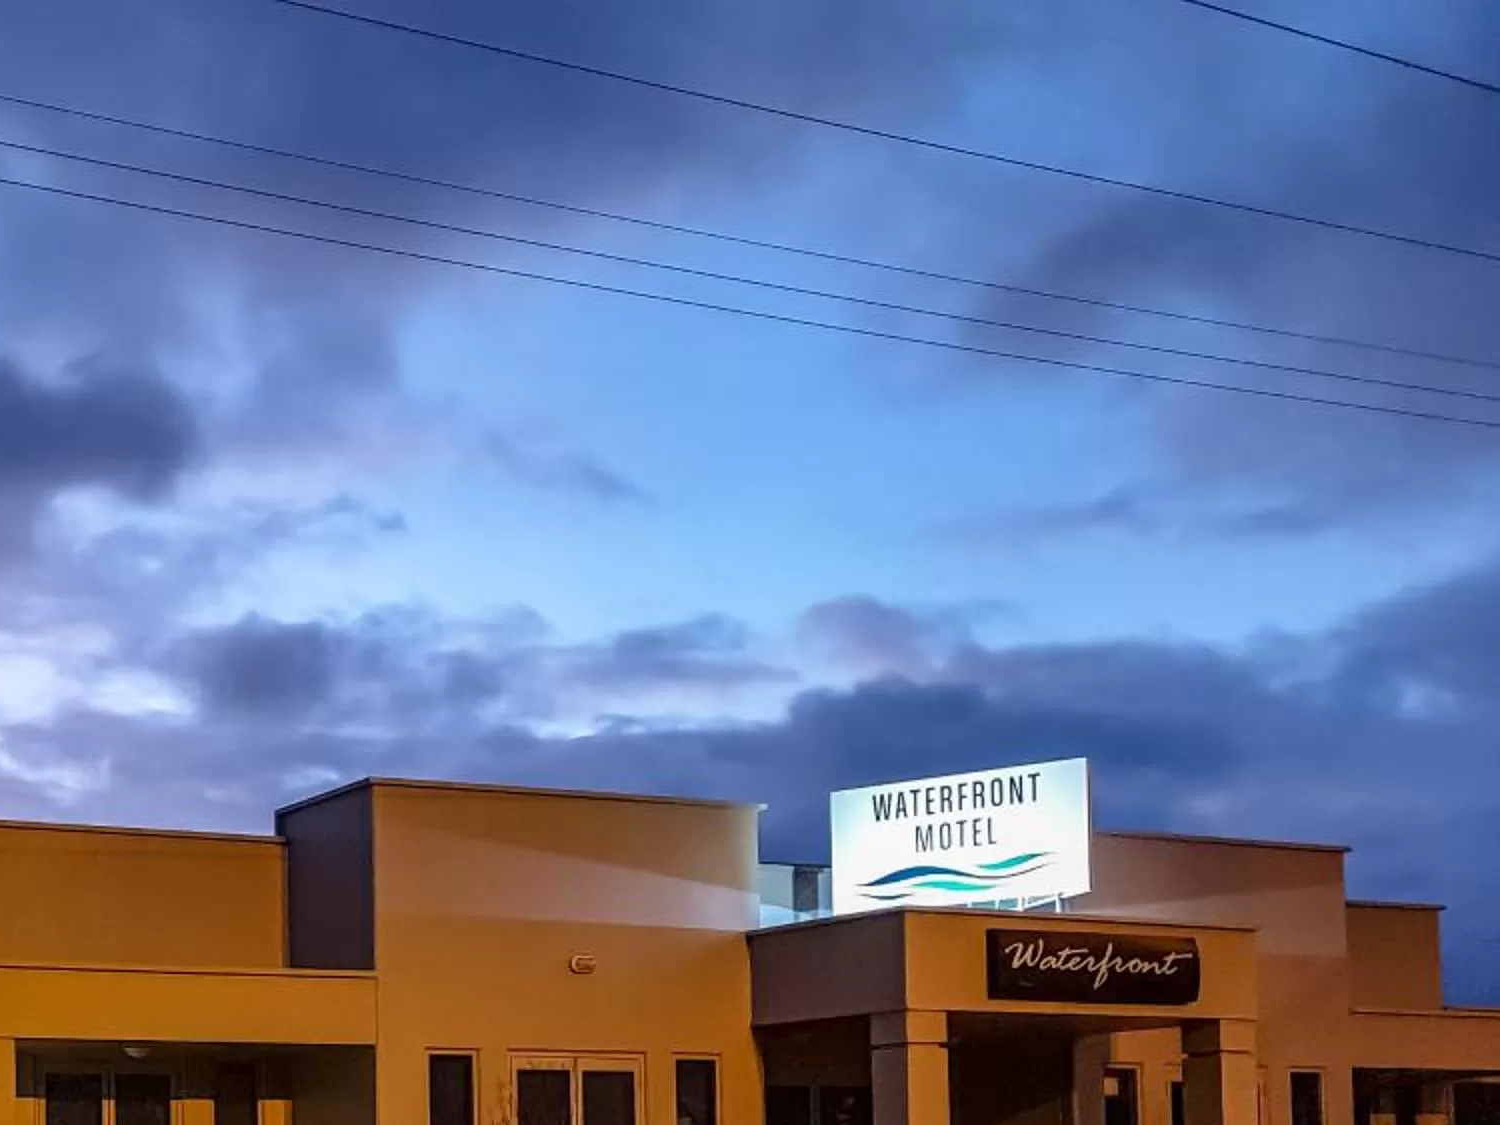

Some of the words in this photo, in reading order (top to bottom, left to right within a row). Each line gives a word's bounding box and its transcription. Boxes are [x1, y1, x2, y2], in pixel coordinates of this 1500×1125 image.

[871, 771, 1041, 822] WATERFRONT
[915, 817, 997, 853] MOTEL
[1004, 938, 1194, 990] Waterfront
